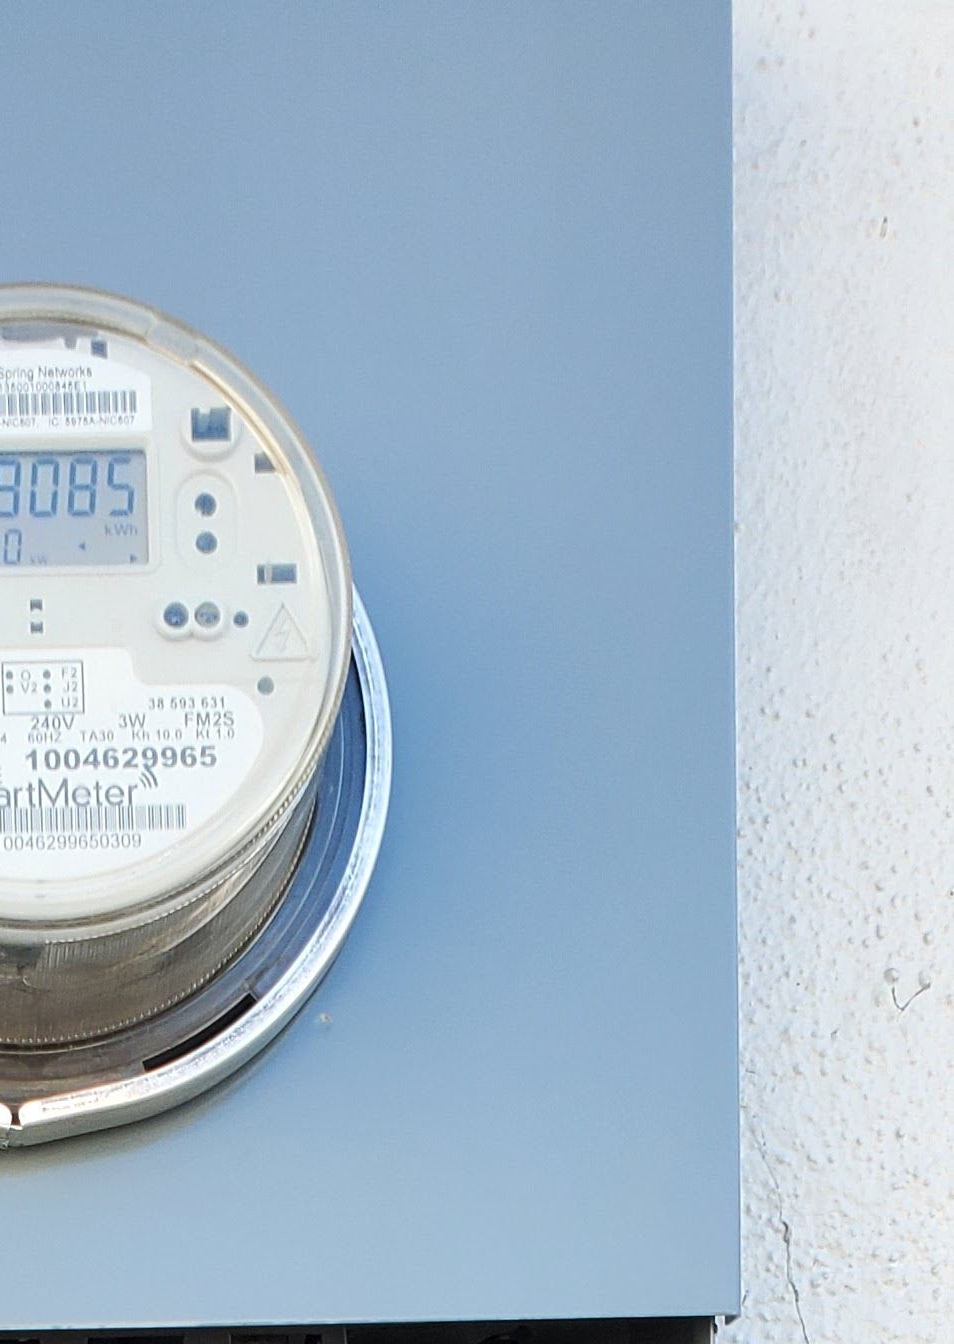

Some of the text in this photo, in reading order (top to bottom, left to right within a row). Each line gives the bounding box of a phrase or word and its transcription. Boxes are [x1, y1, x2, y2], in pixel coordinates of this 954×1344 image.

[39, 365, 92, 378] Networks
[104, 523, 137, 536] kWh
[20, 683, 37, 693] V2
[149, 697, 225, 709] 38 593 631
[31, 717, 75, 730] 240V
[119, 714, 146, 728] 3W
[184, 712, 234, 727] FM2S
[81, 731, 114, 741] TA30
[25, 745, 217, 770] 1004629965
